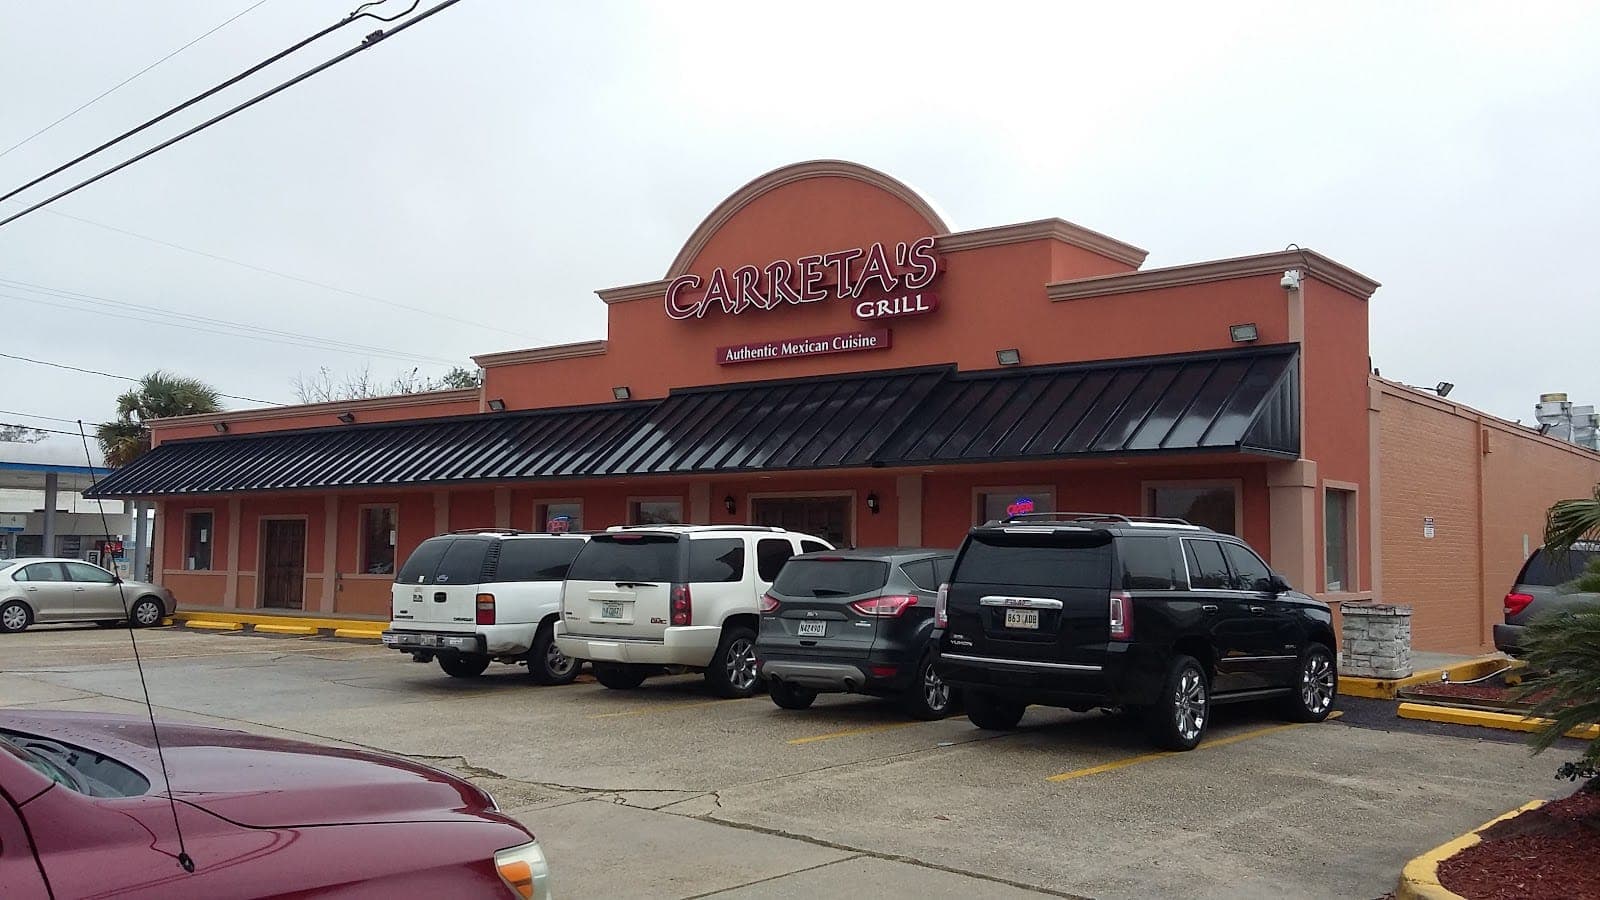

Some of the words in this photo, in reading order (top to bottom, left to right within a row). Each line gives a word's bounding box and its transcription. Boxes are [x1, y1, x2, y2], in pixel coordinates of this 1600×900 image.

[664, 236, 938, 320] CARRETA'S
[856, 294, 930, 318] GRILL
[725, 344, 778, 362] Authentic
[781, 340, 829, 355] Mexican
[832, 334, 877, 349] Cuisine
